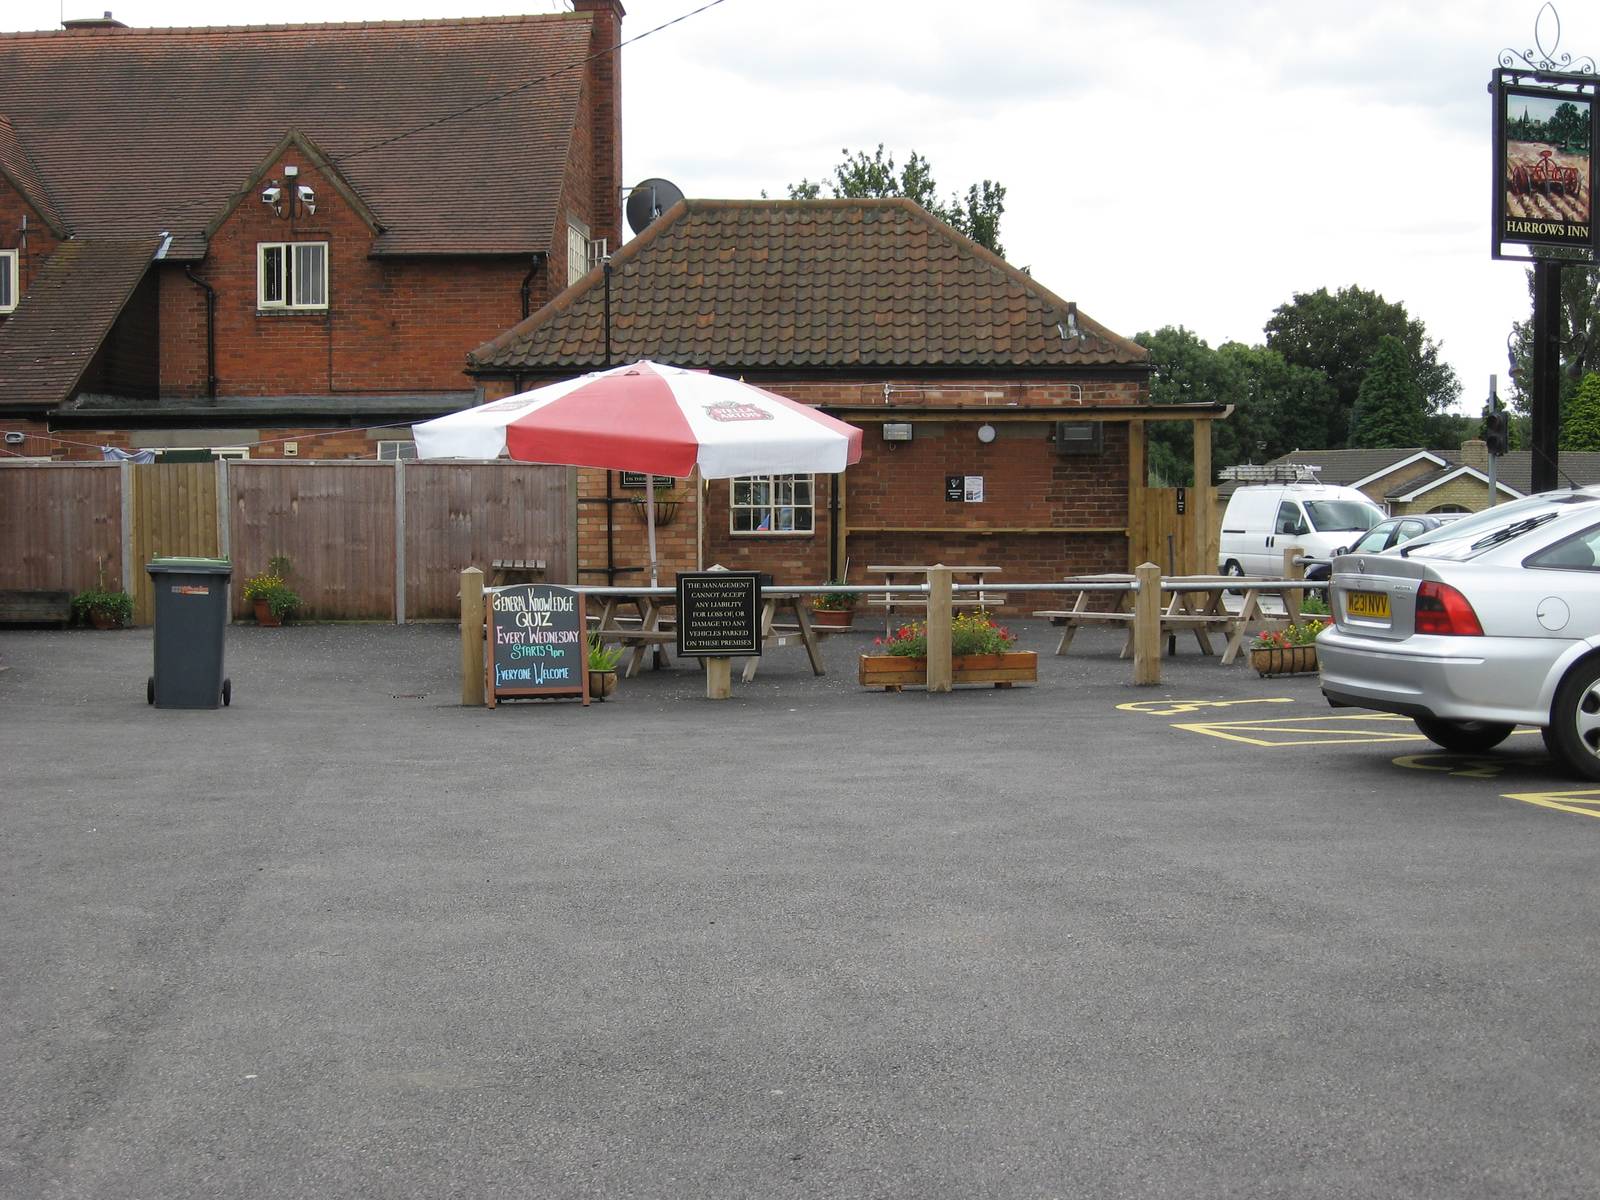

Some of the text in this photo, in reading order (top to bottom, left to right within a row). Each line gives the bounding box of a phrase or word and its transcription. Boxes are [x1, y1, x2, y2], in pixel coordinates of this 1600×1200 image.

[1506, 220, 1589, 238] HARROWS INN
[515, 611, 553, 627] QUIZ
[496, 625, 579, 644] EVERY WEDNESDAY
[510, 644, 565, 660] STARTS 9pm
[532, 662, 570, 685] WELCOME
